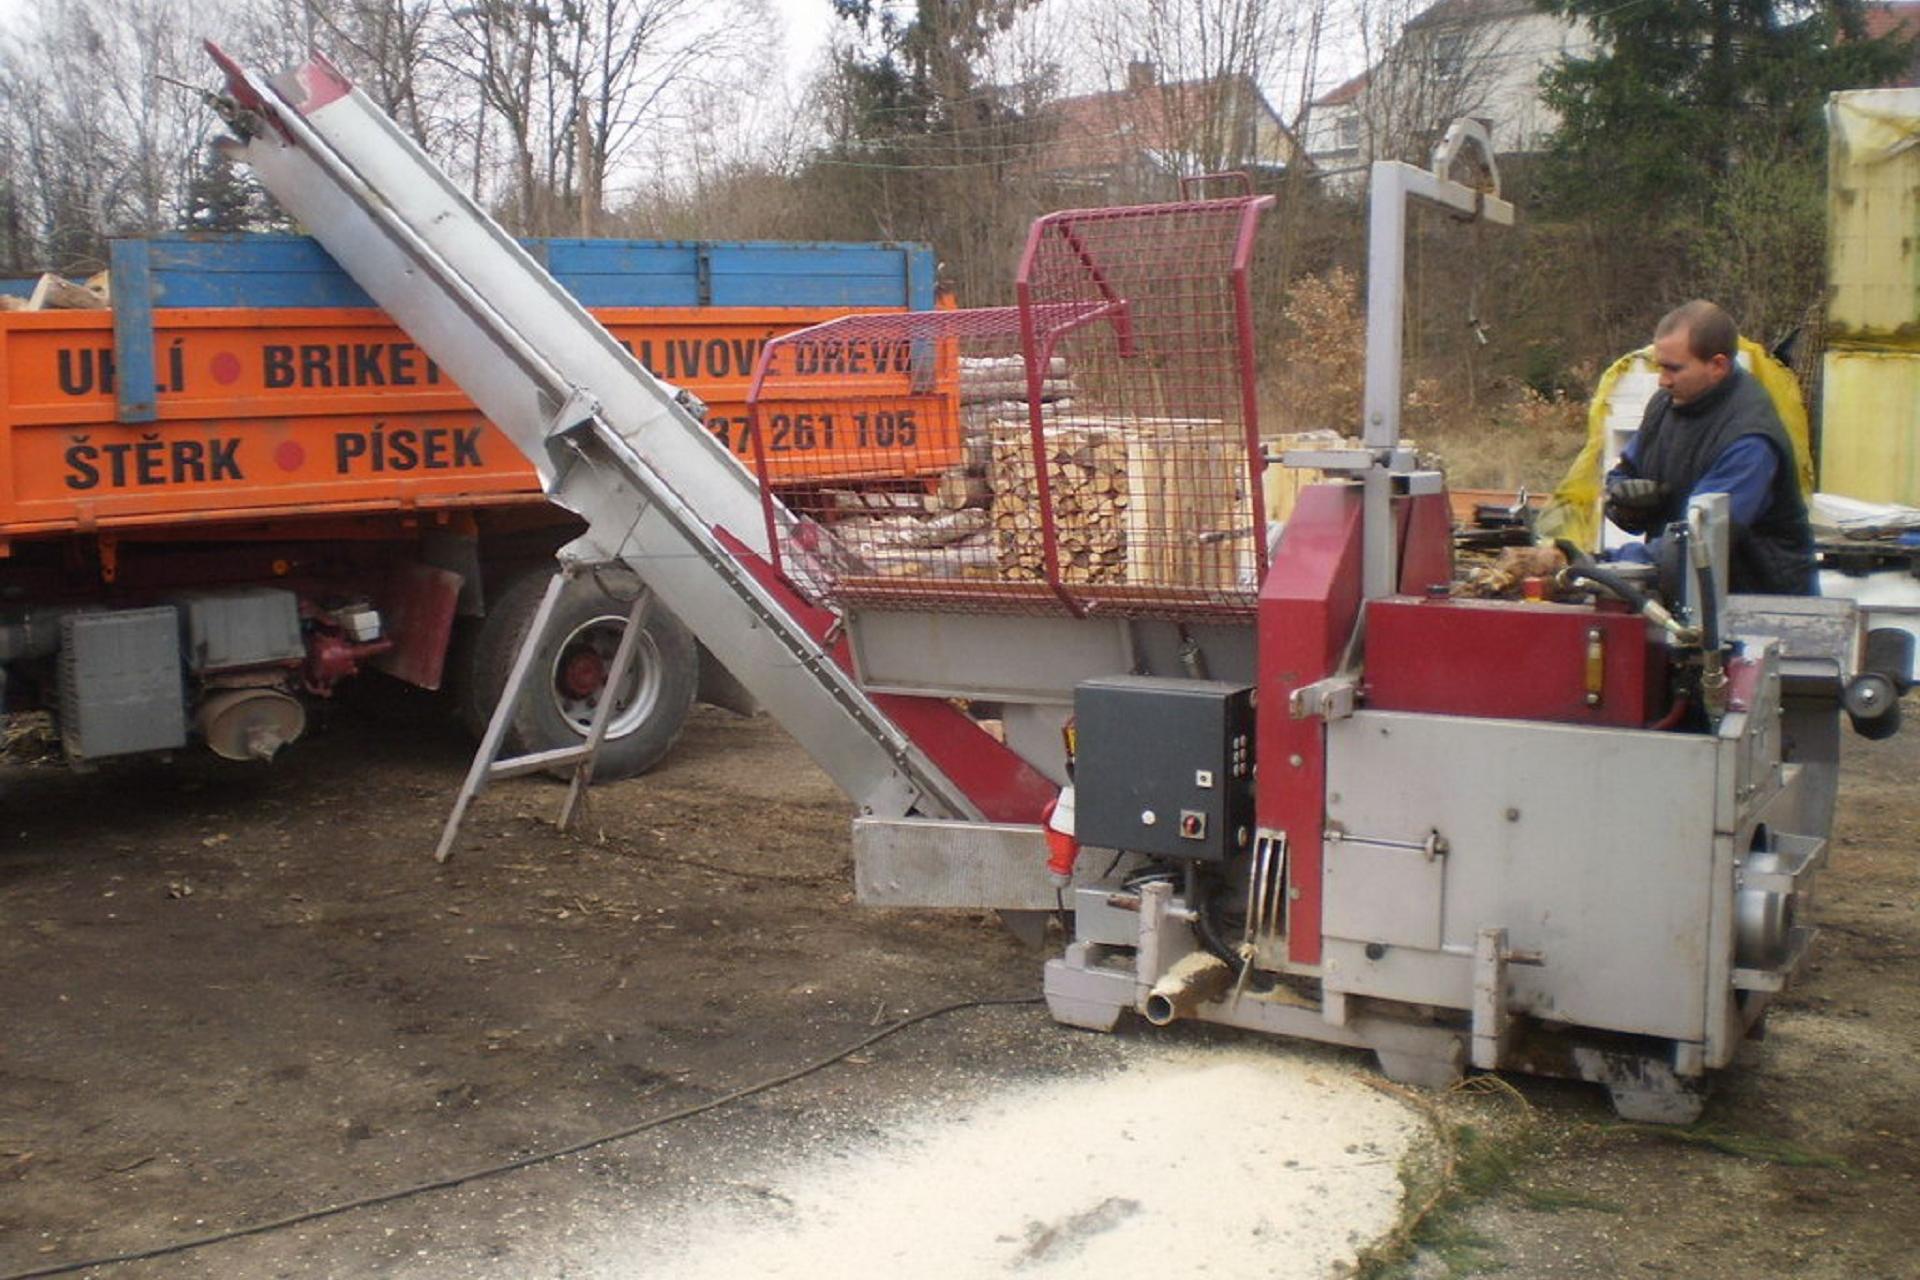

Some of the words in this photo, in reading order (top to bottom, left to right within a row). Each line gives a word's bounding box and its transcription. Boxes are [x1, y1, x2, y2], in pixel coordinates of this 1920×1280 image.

[620, 331, 781, 378] LIVOVÉ
[65, 434, 244, 490] ŠTĚRK
[336, 421, 484, 474] PÍSEK
[771, 412, 834, 451] 261
[853, 409, 917, 448] 105
